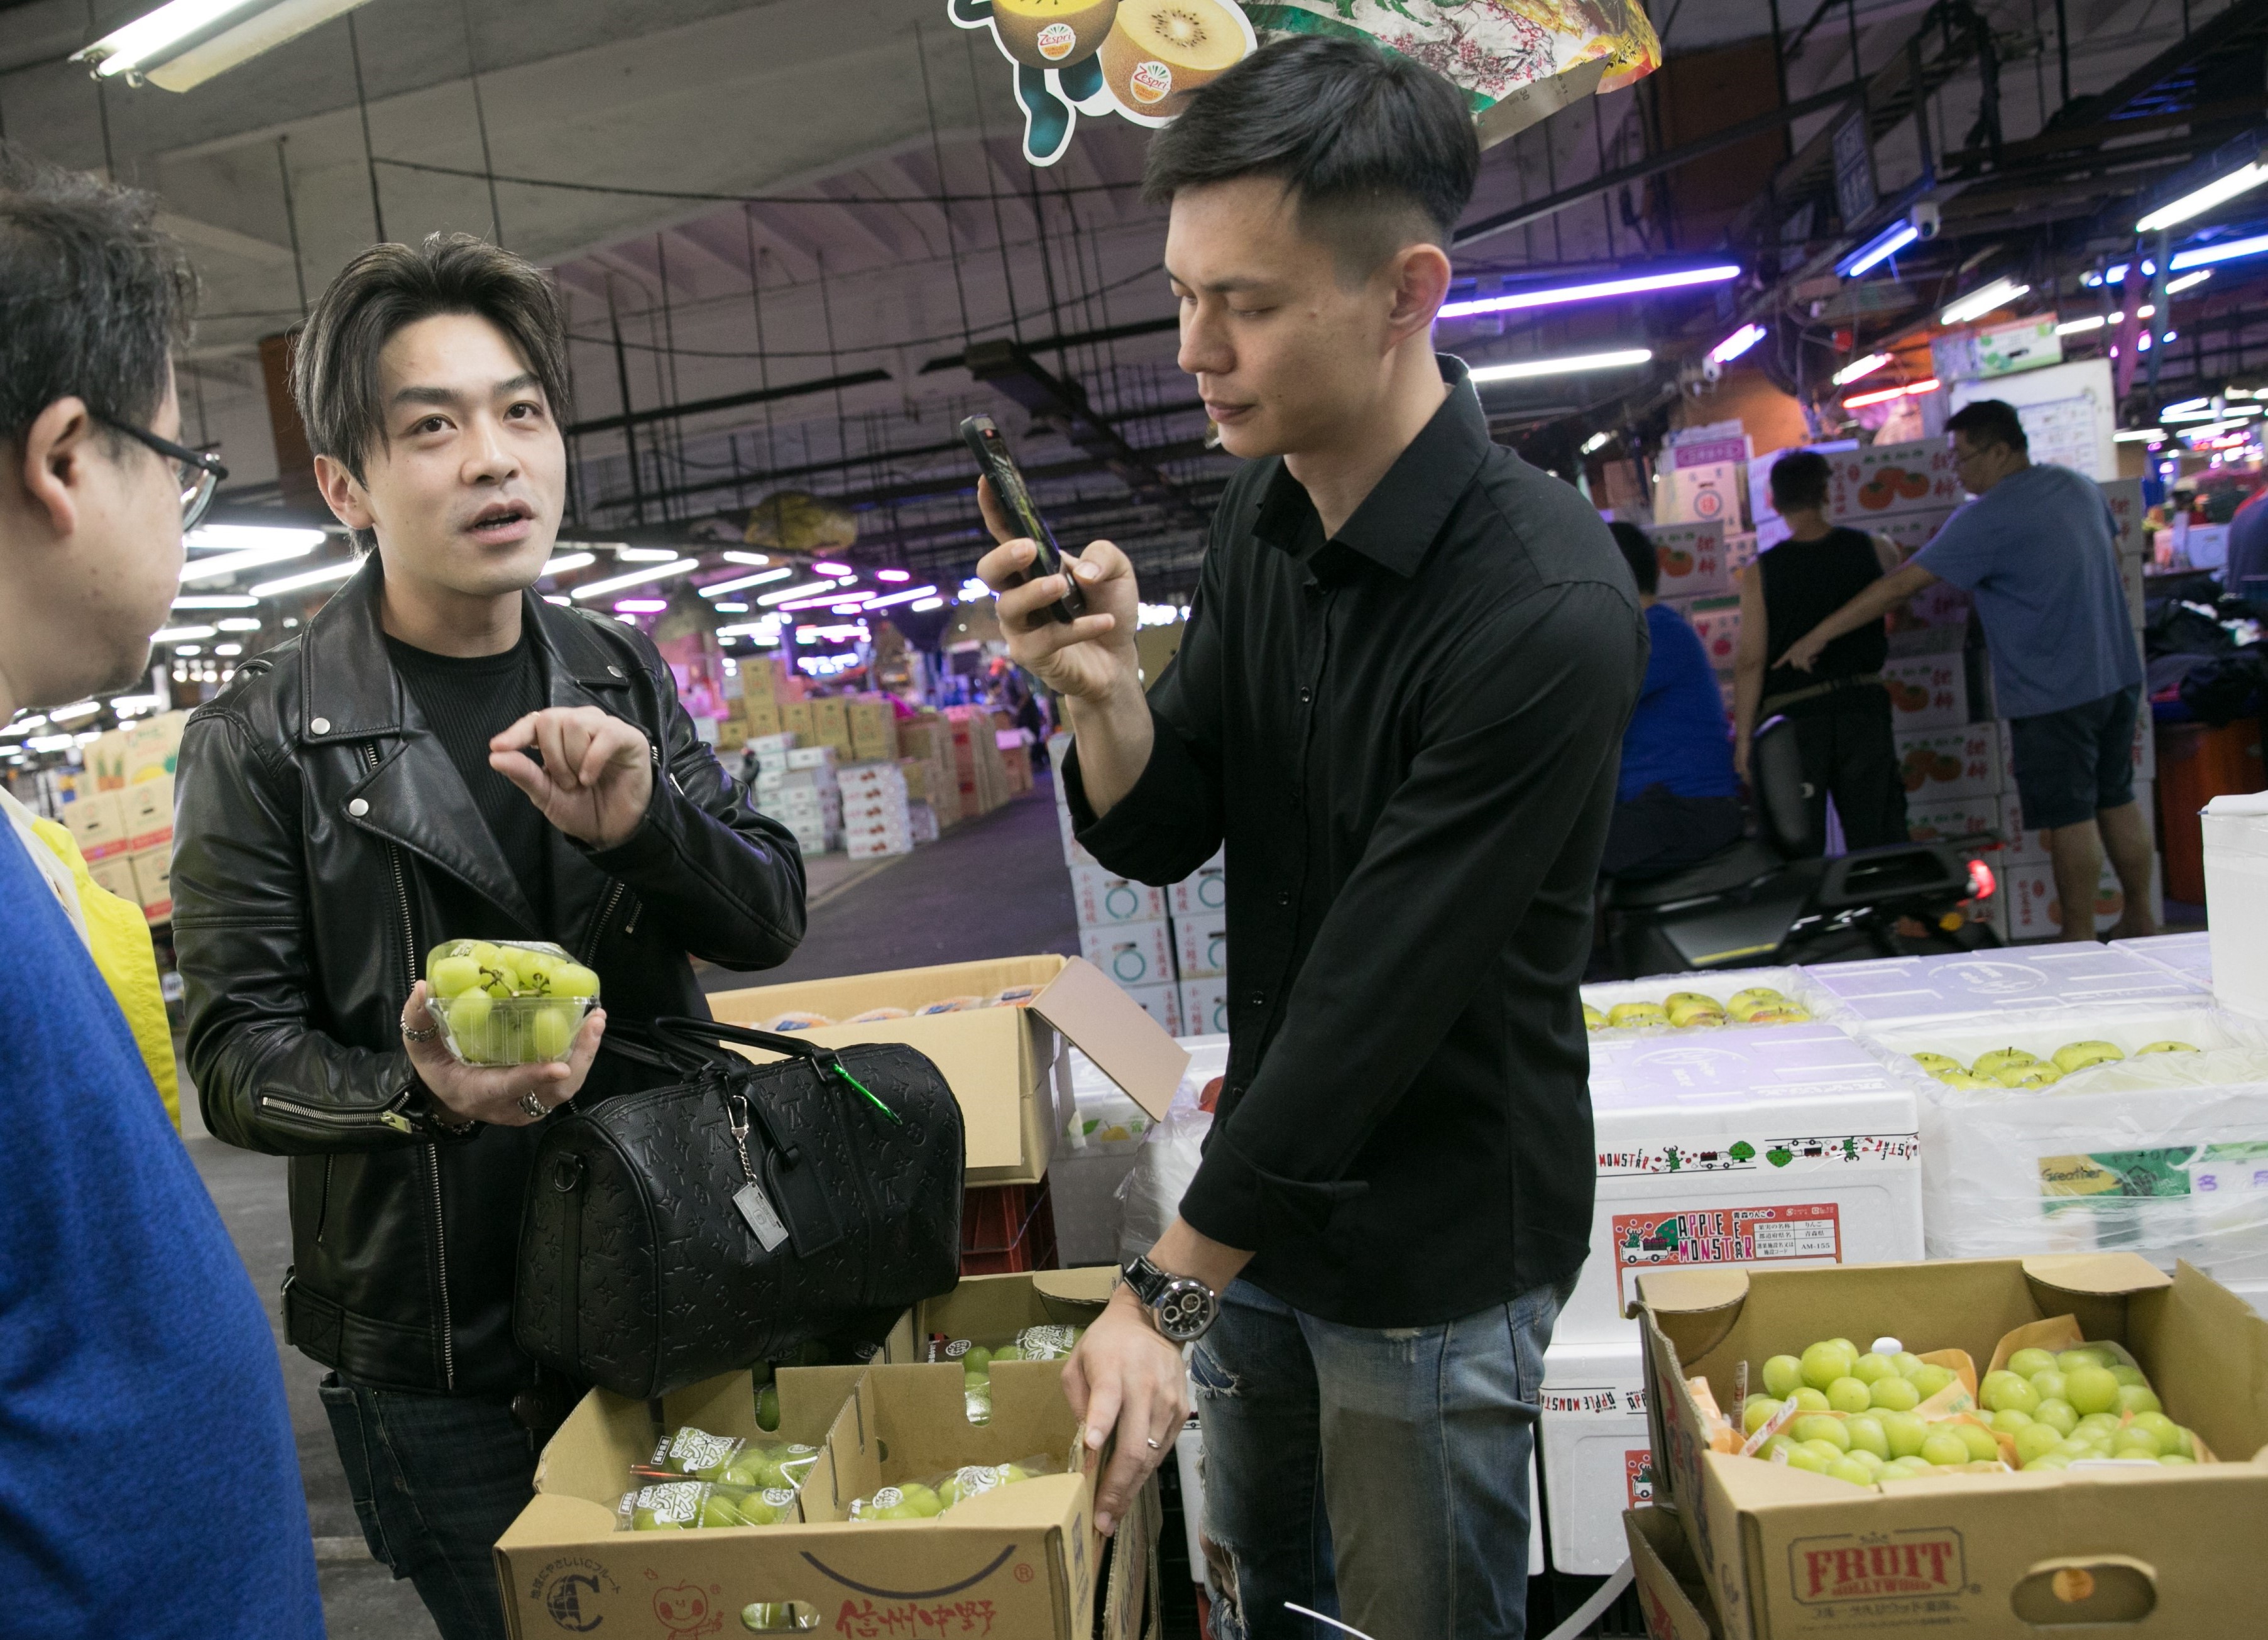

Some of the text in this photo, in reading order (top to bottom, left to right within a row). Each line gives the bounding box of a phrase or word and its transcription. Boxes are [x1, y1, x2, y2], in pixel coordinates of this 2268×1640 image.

[1039, 33, 1071, 45] Zespri
[1134, 65, 1170, 89] Zespri
[1135, 83, 1158, 98] SUNGOLD
[1733, 1211, 1766, 1219] 青森りんご
[1677, 1213, 1724, 1238] APPLE
[1758, 1223, 1791, 1231] 果実の名称
[1759, 1232, 1792, 1240] 都道府県名
[1801, 1242, 1831, 1250] AM-155
[1583, 1391, 1616, 1410] APPLE
[654, 1438, 671, 1463] 長野県産
[1804, 1541, 1953, 1599] FRUIT
[835, 1599, 996, 1639] 信州中野
